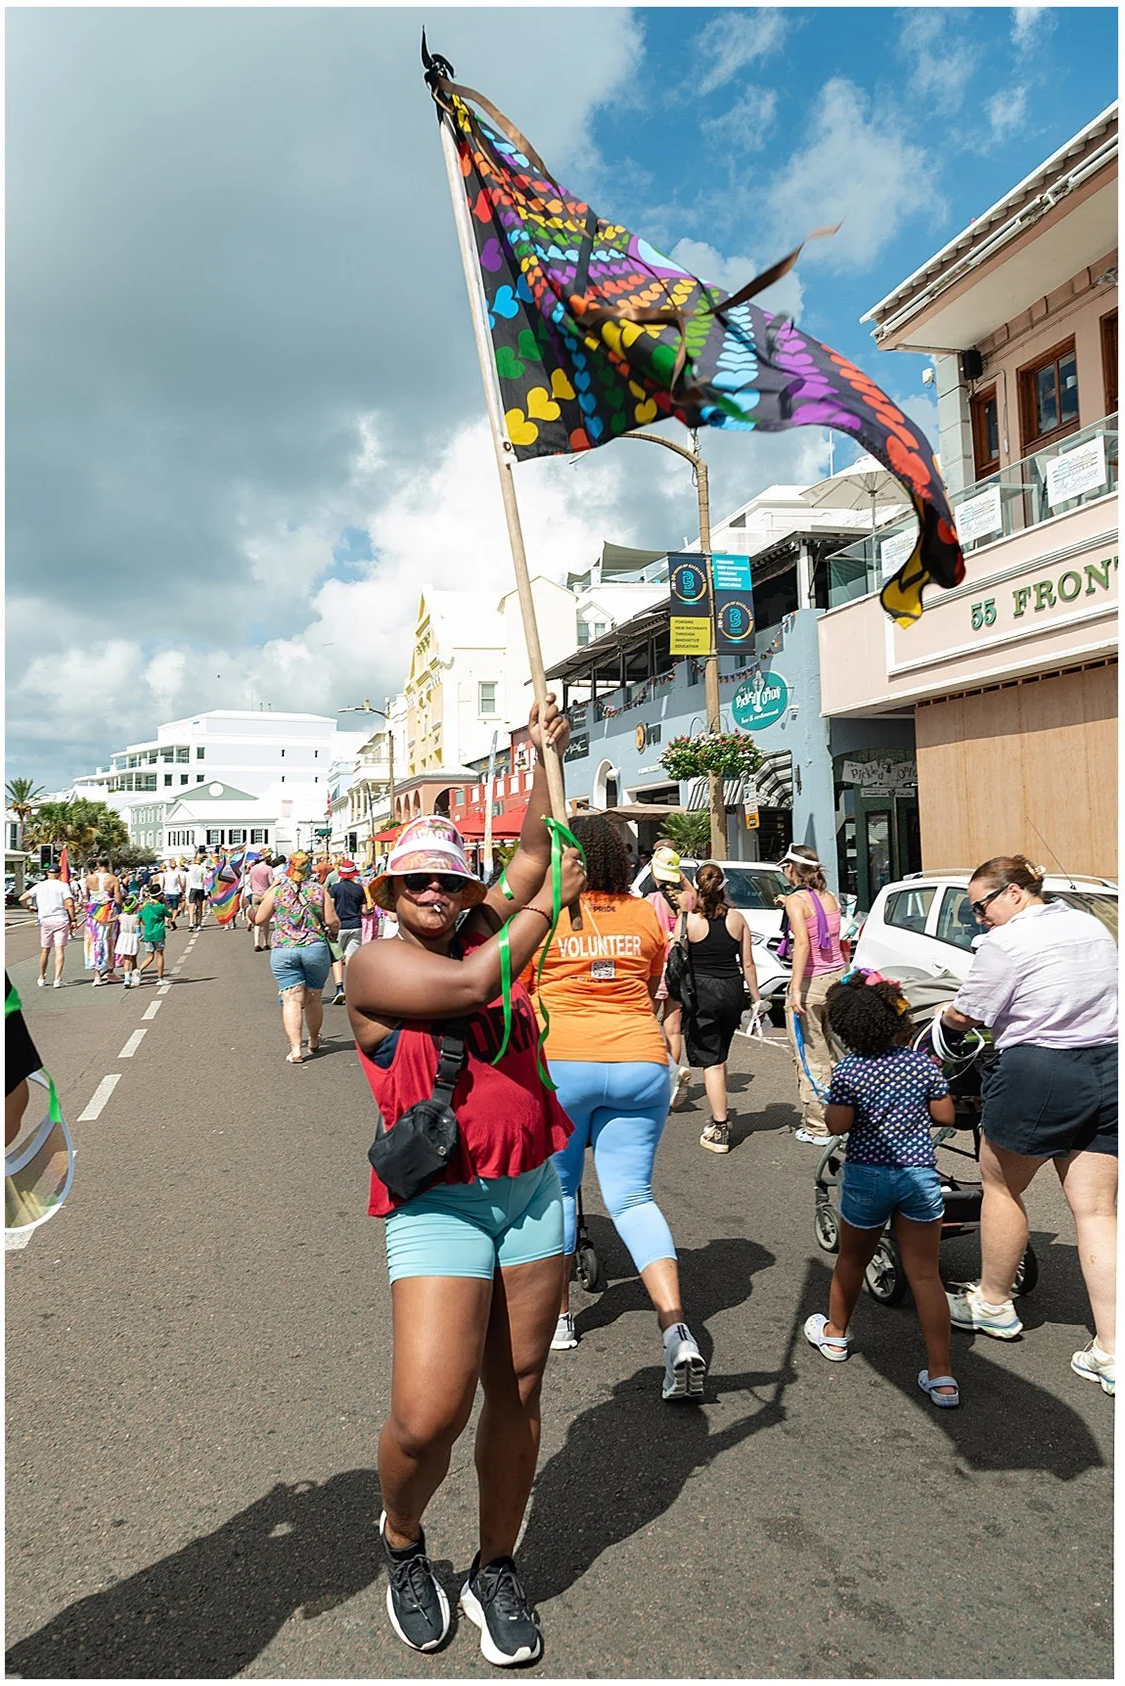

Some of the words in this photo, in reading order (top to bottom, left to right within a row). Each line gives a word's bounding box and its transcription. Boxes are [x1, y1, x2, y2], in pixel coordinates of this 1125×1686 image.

[970, 597, 997, 630] 55
[851, 765, 884, 780] Pickled
[557, 934, 642, 958] VOLUNTEER
